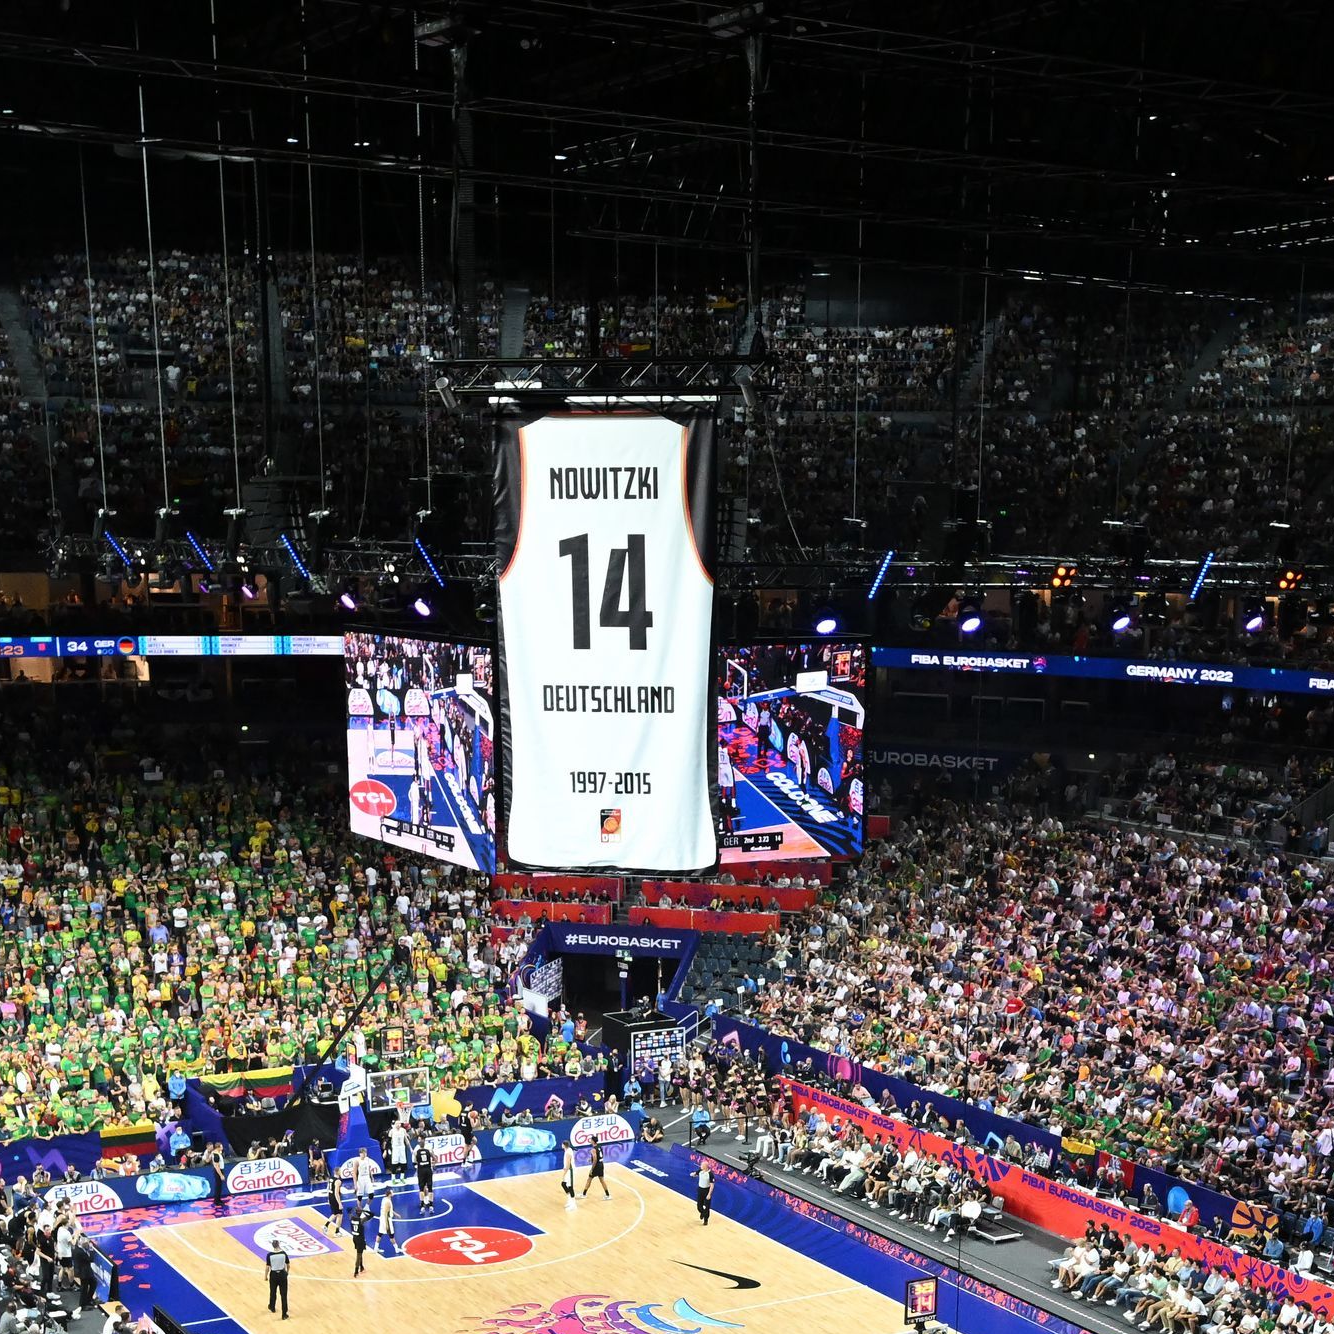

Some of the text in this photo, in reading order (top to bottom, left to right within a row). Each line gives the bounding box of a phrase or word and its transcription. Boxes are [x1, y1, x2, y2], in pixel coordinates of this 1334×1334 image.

[550, 467, 658, 500] NOWITZKI
[559, 533, 653, 650] 14
[67, 641, 88, 652] 34
[912, 655, 1029, 672] FIBA EUROBASKET
[1127, 665, 1233, 684] GERMANY 2022
[543, 684, 675, 713] DEUTSCHLAND
[570, 771, 651, 795] 1997-2015
[353, 791, 393, 804] TCL
[724, 838, 739, 847] GER
[565, 933, 681, 950] #EUROBASKET
[792, 1084, 895, 1132] FIBA EUROBASKET 2022
[1022, 1172, 1161, 1236] FIBA EUROBASKET 2022
[441, 1230, 500, 1264] TCL
[915, 1314, 937, 1323] TISSOT
